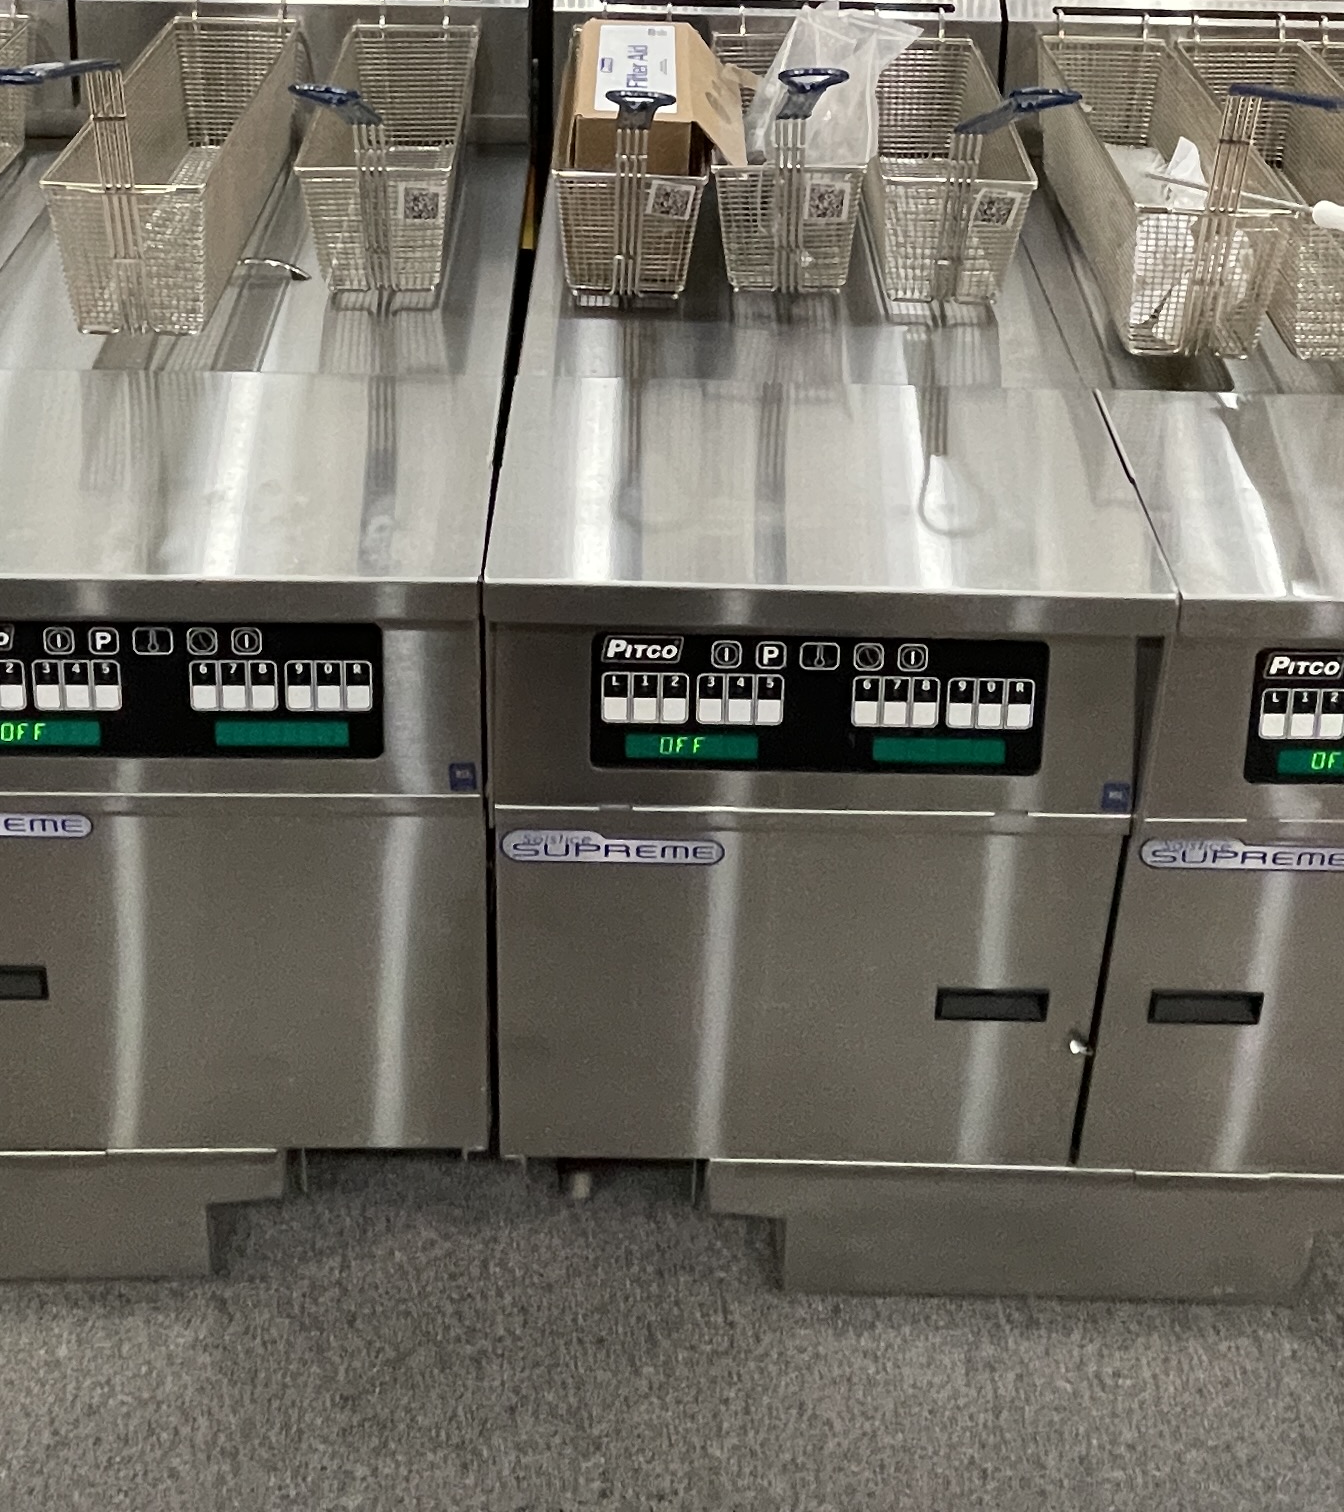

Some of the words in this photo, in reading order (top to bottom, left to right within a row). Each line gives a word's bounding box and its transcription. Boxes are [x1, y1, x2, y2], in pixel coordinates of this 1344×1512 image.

[95, 632, 112, 650] P
[763, 646, 779, 665] P
[0, 722, 46, 742] OFF
[659, 736, 706, 755] OFF
[512, 843, 715, 860] SUPREME
